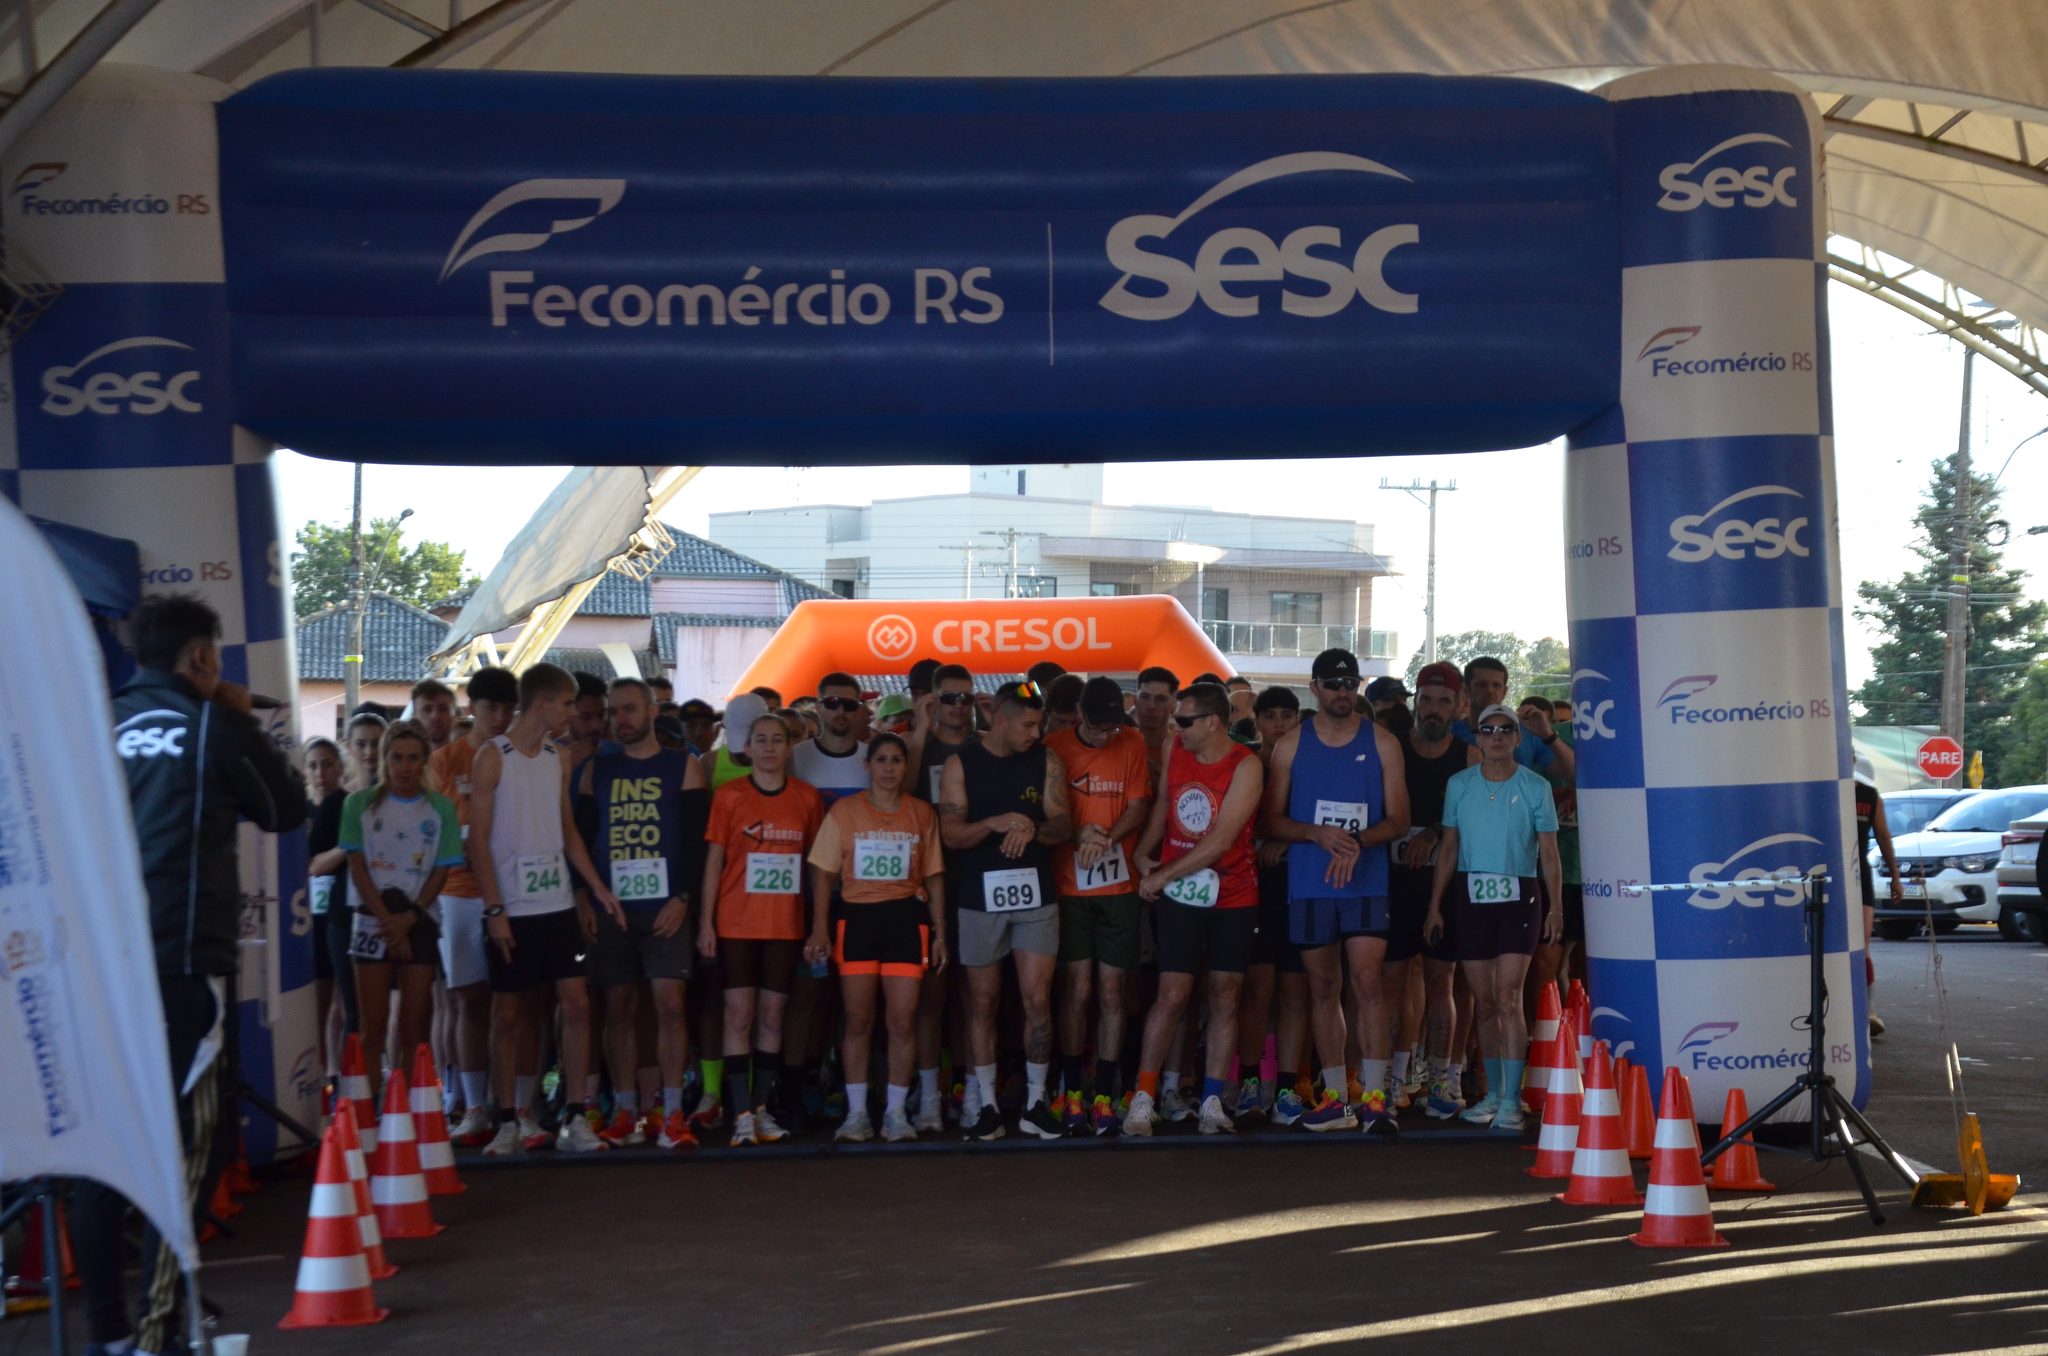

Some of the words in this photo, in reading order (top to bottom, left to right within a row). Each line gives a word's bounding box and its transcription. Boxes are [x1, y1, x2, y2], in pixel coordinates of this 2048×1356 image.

[1656, 162, 1798, 212] Sesc
[21, 192, 169, 216] Fecomércio
[176, 193, 211, 215] RS
[1097, 213, 1419, 321] Sesc
[488, 265, 891, 327] Fecomércio
[914, 267, 1005, 327] RS
[1652, 351, 1787, 378] Fecomércio
[1791, 351, 1814, 372] RS
[40, 365, 203, 416] Sesc
[1666, 514, 1810, 563] Sesc
[200, 561, 233, 582] RS
[931, 616, 1113, 654] CRESOL
[1670, 700, 1805, 725] Fecomércio
[1809, 698, 1831, 719] RS
[115, 726, 188, 758] esc
[1919, 750, 1962, 766] PARE
[610, 776, 663, 803] INS
[609, 802, 661, 824] PIRA
[609, 824, 661, 847] ECO
[752, 867, 794, 890] 226
[861, 854, 903, 877] 268
[525, 866, 562, 894] 244
[618, 872, 661, 898] 289
[1169, 876, 1212, 904] 334
[1473, 876, 1514, 900] 283
[992, 883, 1035, 908] 689
[1691, 1047, 1812, 1071] Fecomérc
[1830, 1043, 1852, 1064] RS
